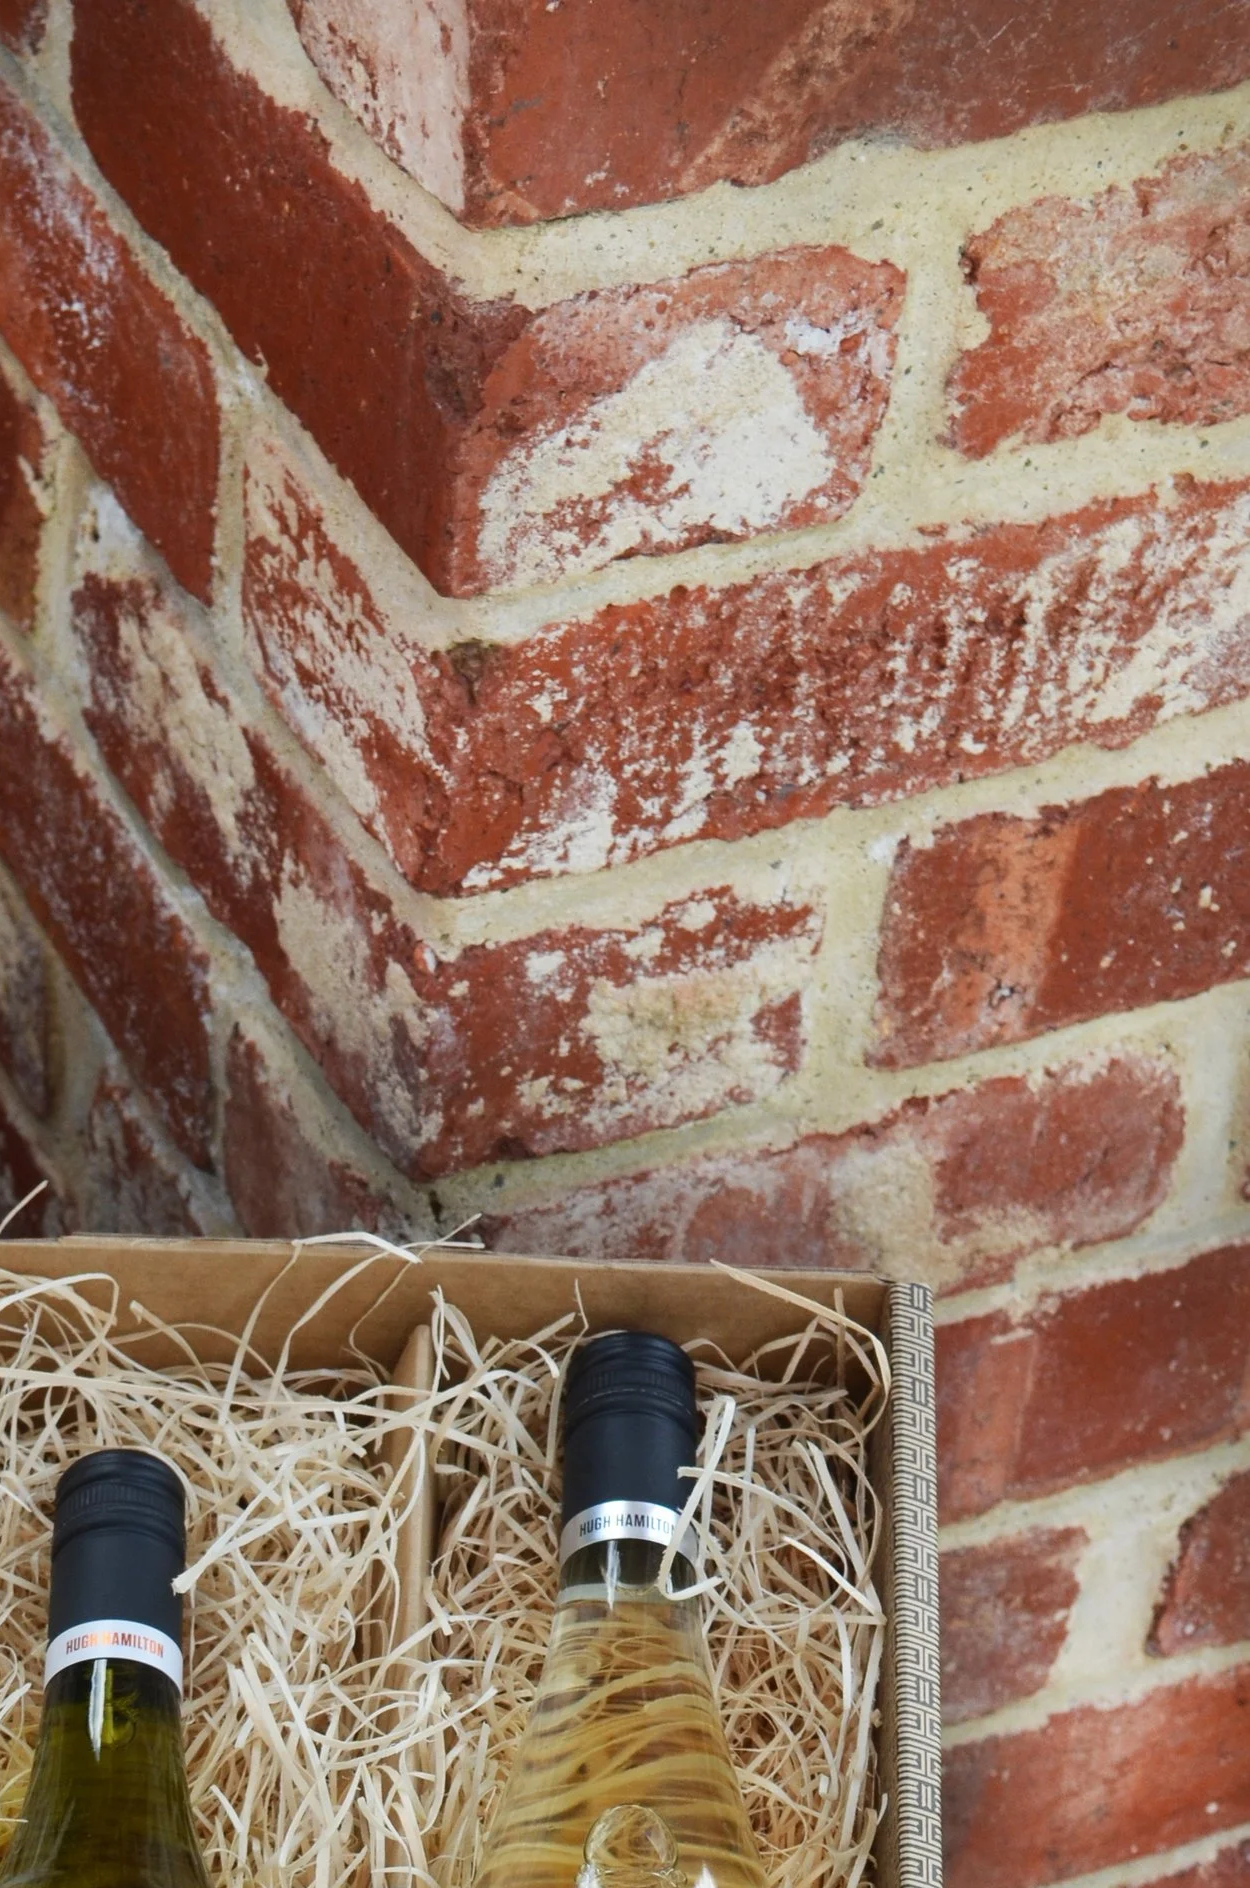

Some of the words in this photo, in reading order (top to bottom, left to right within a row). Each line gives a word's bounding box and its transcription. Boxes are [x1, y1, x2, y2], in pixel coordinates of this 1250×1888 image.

[579, 1515, 611, 1537] HUGH
[65, 1633, 99, 1655] HUGH
[102, 1631, 165, 1658] HAMILTON
